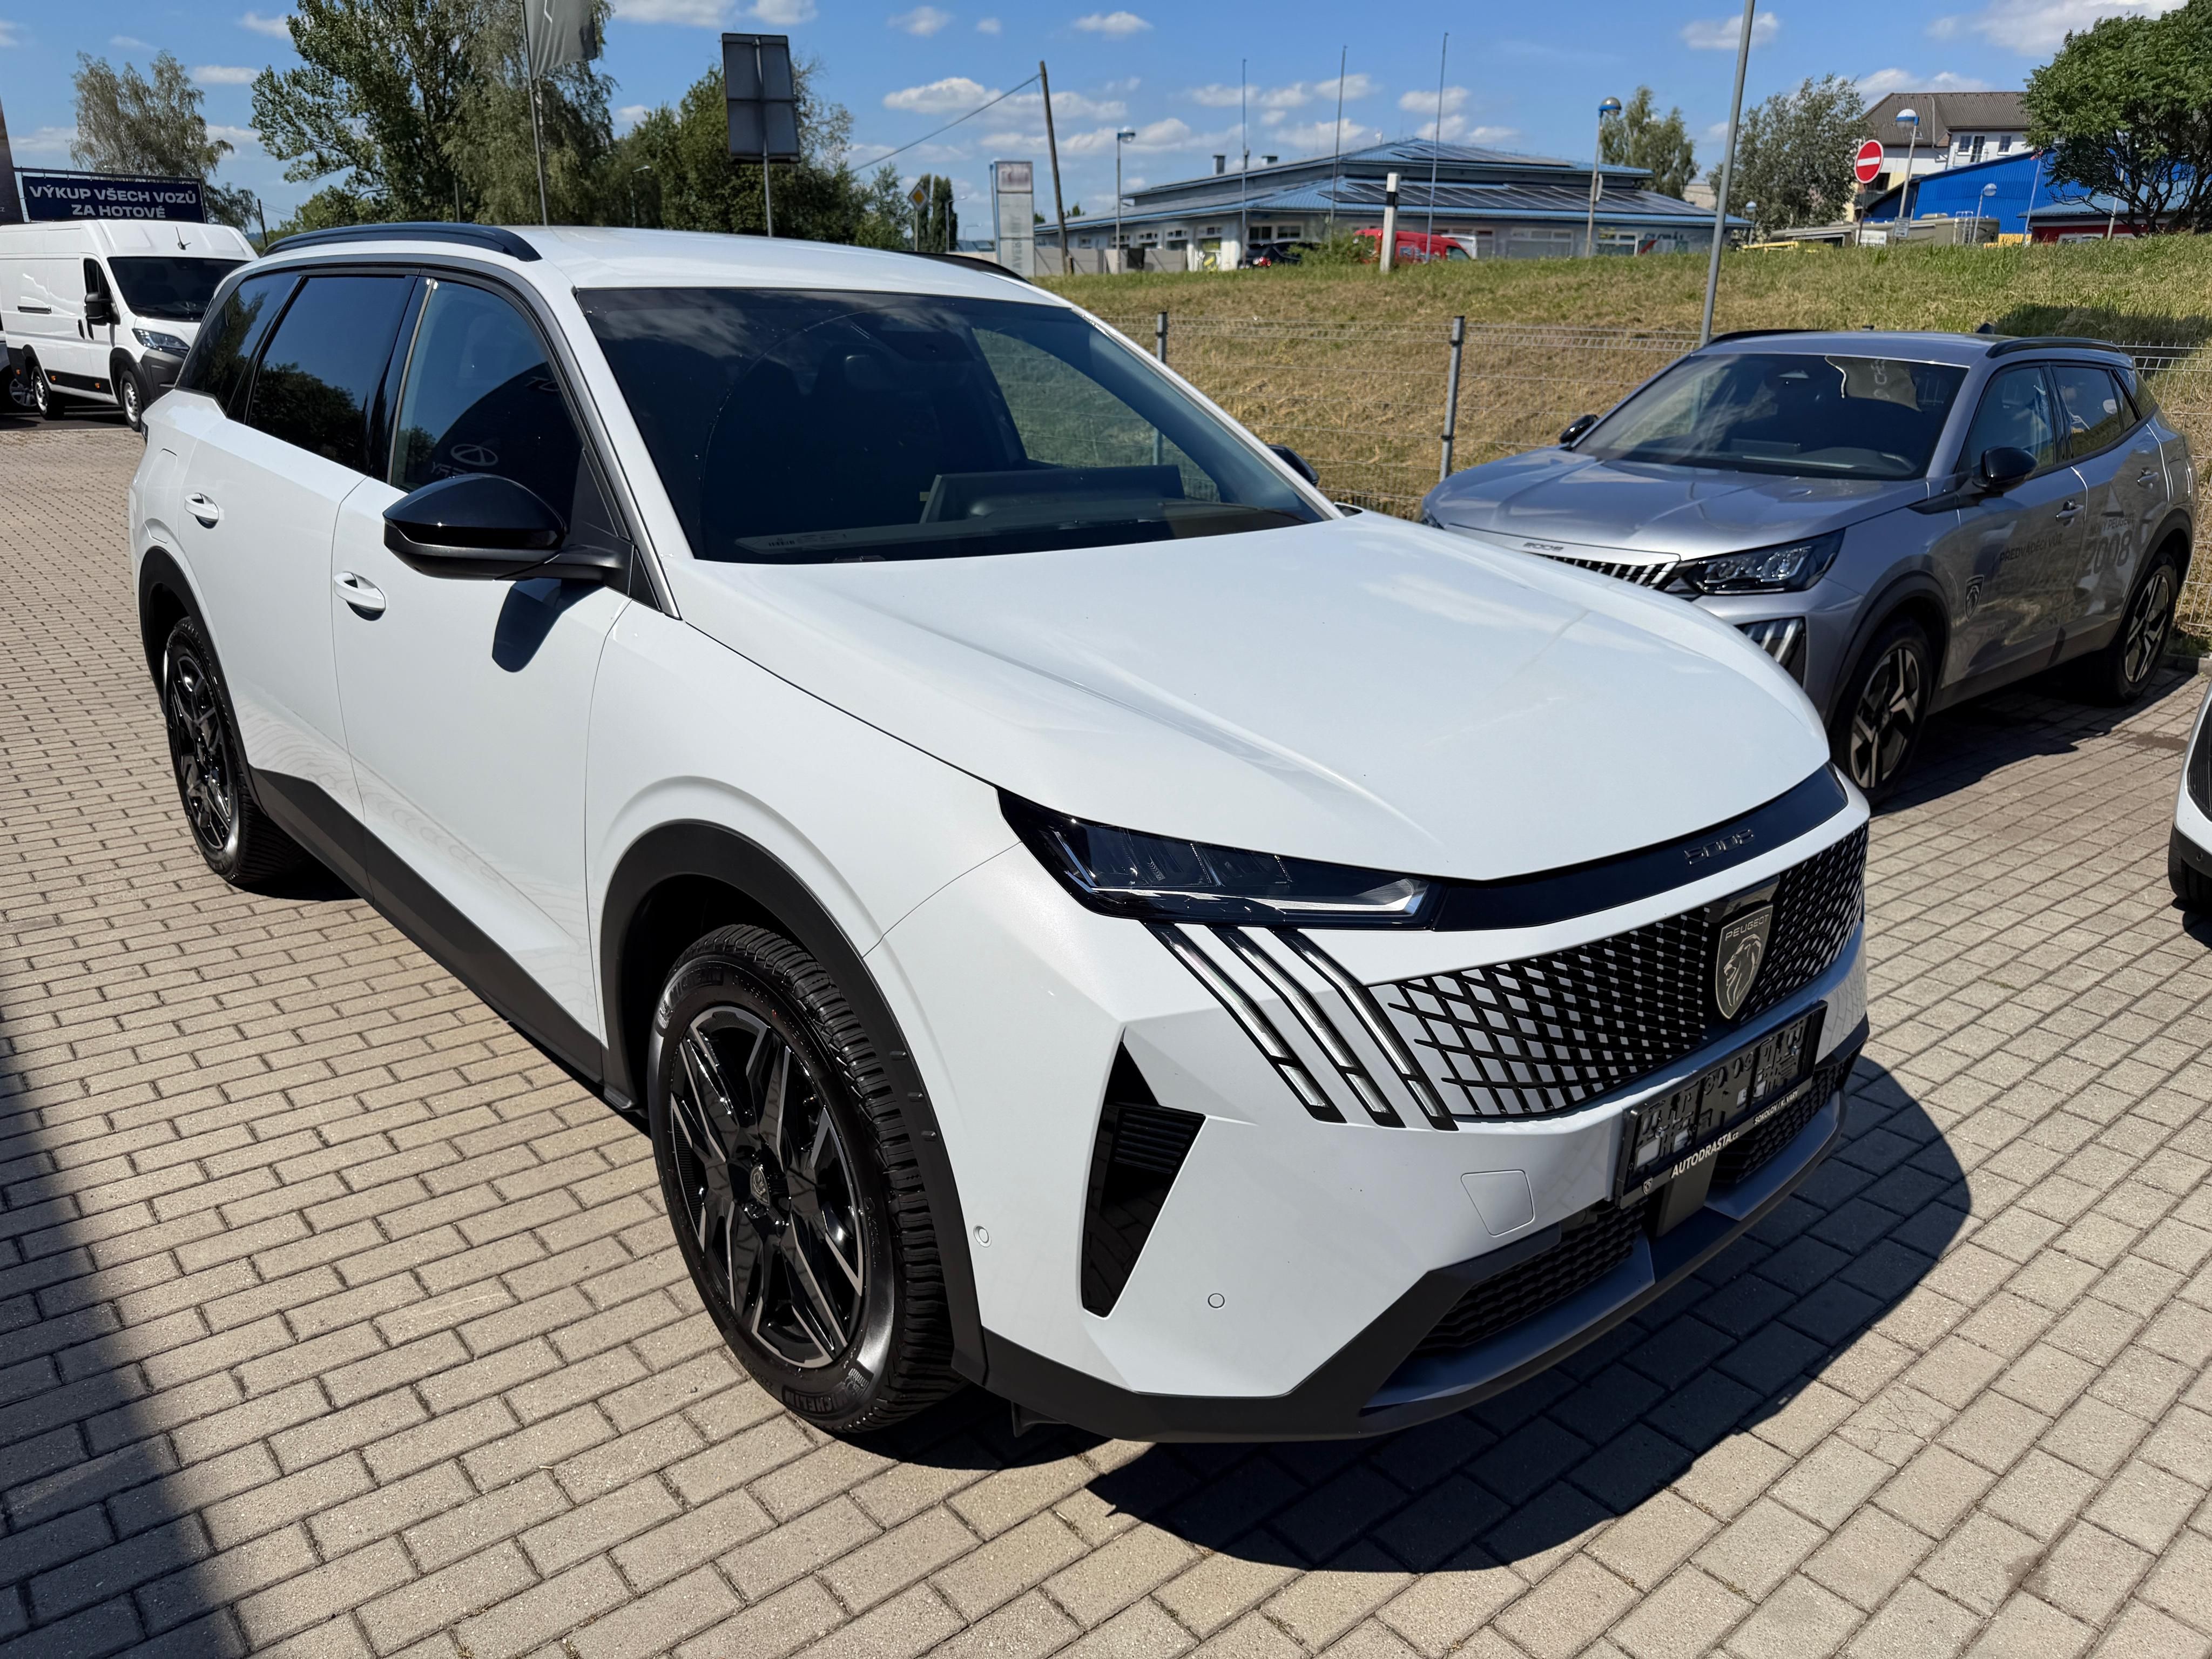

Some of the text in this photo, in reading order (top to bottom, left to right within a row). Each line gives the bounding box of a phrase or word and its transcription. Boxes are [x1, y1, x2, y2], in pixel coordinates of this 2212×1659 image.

[29, 185, 196, 204] VÝKUP VŠECH VOZŮ
[71, 204, 166, 219] ZA HOTOVÉ
[2080, 530, 2133, 576] 2008
[1684, 829, 1755, 865] 5008
[1725, 914, 1770, 942] PEUGEOT
[1754, 1103, 1778, 1125] SOKOLOV
[1786, 1089, 1799, 1102] VARY
[784, 1389, 848, 1413] MICHELIN
